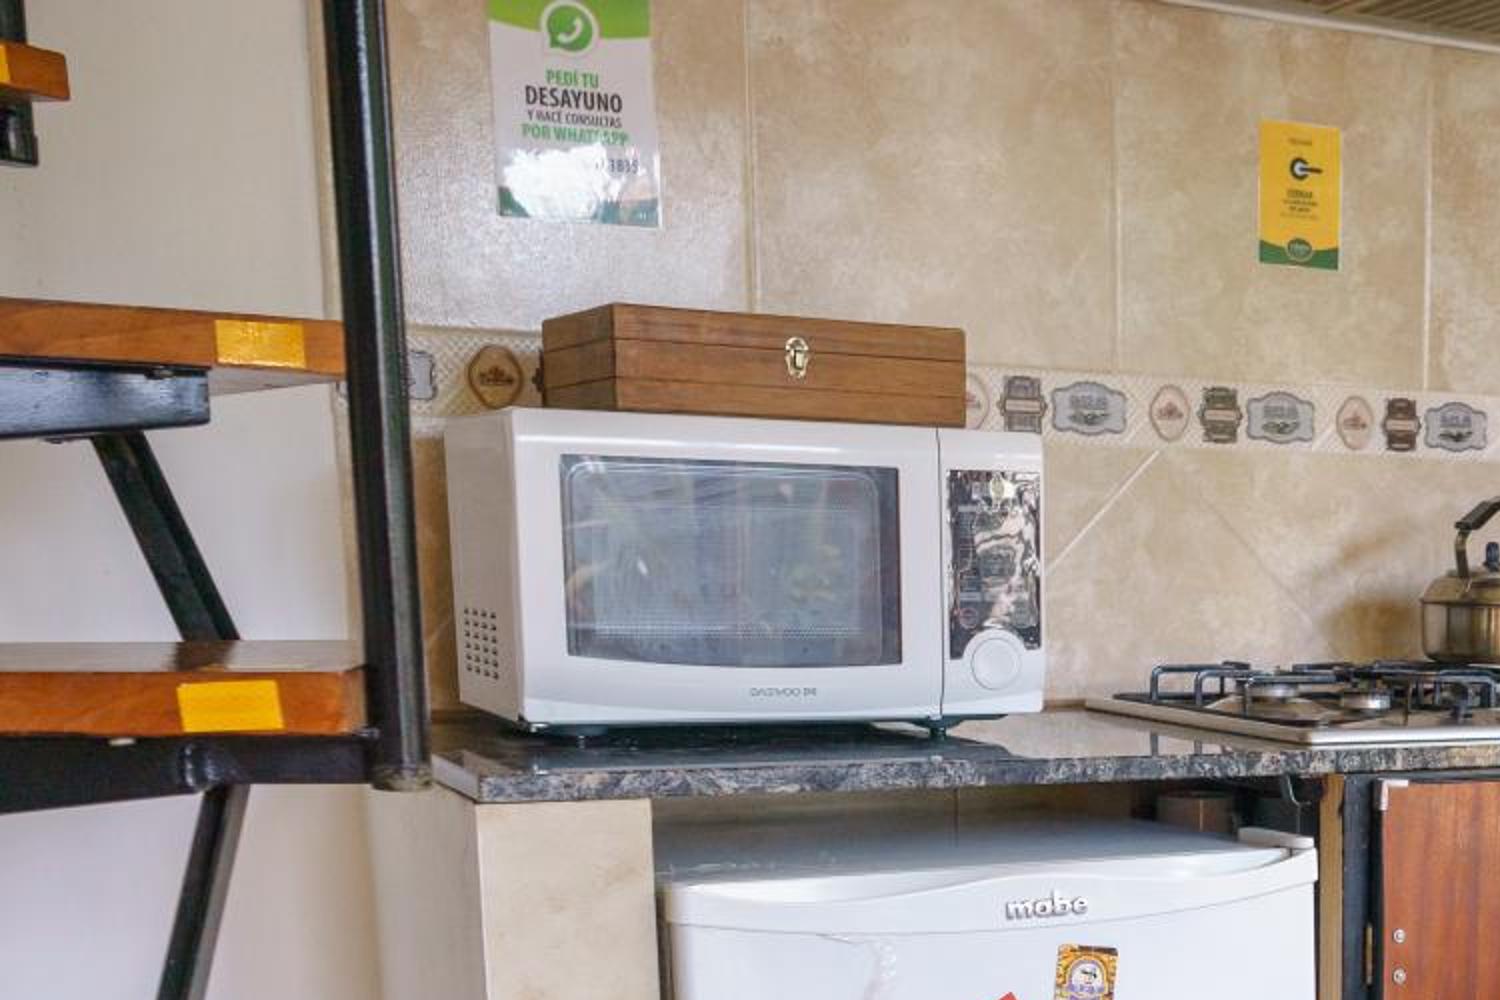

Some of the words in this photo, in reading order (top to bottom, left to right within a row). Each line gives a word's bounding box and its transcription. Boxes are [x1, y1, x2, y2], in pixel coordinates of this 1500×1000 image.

[582, 72, 599, 88] TU
[525, 85, 623, 113] DESAYUNO
[522, 123, 551, 140] POR
[1006, 890, 1088, 919] mabe
